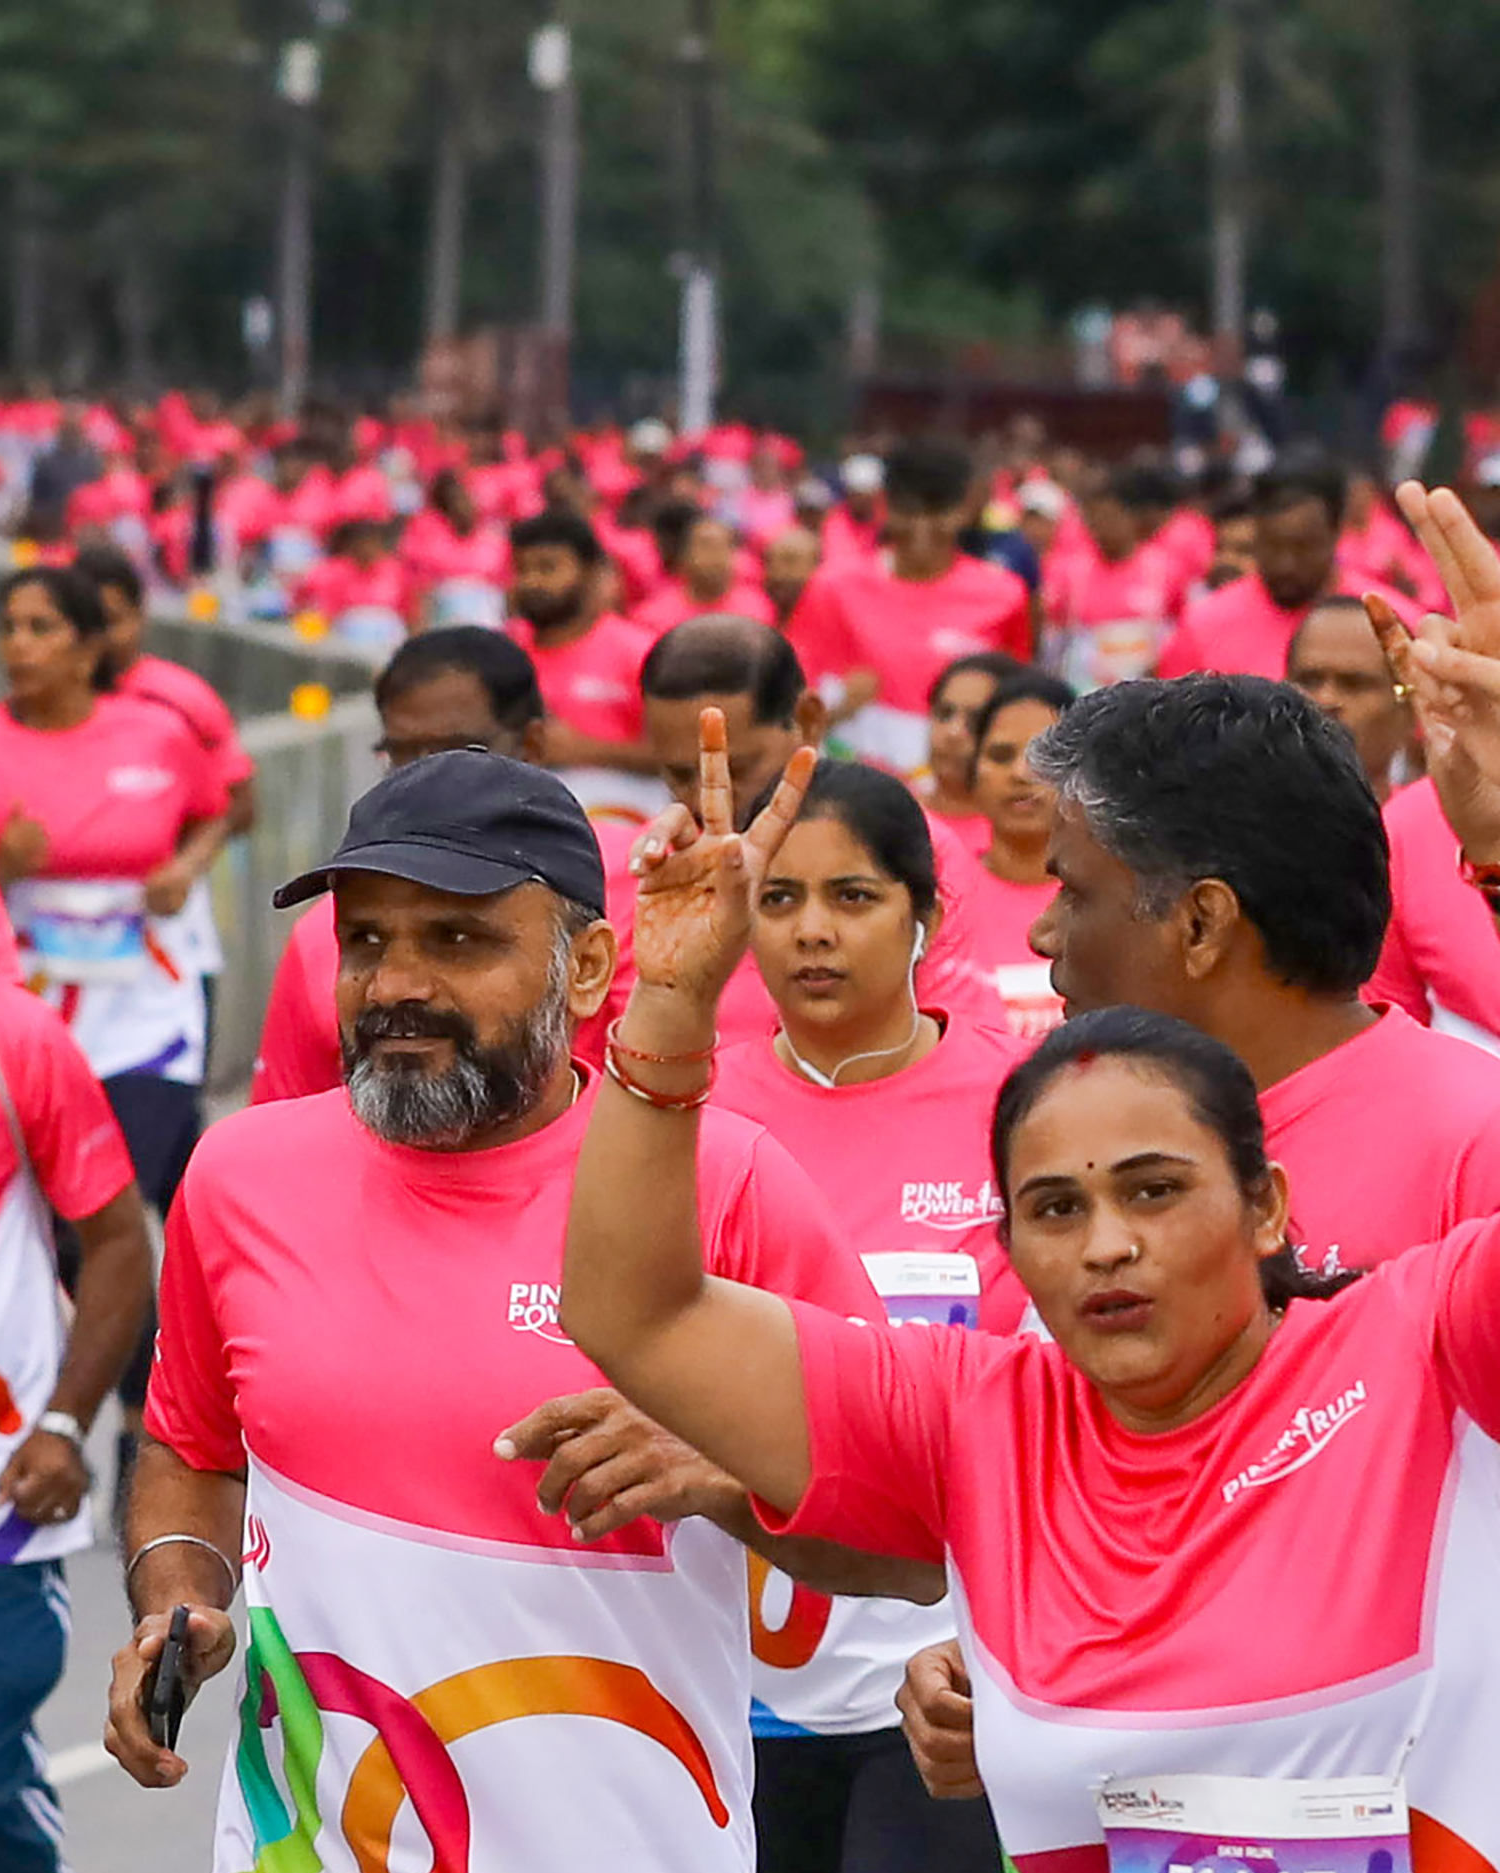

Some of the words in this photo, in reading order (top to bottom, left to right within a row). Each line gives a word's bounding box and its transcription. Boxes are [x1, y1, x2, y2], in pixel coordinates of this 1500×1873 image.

[903, 1181, 963, 1200] PINK
[900, 1197, 975, 1219] POWER
[510, 1283, 562, 1306] PIN
[1309, 1380, 1367, 1434] RUN
